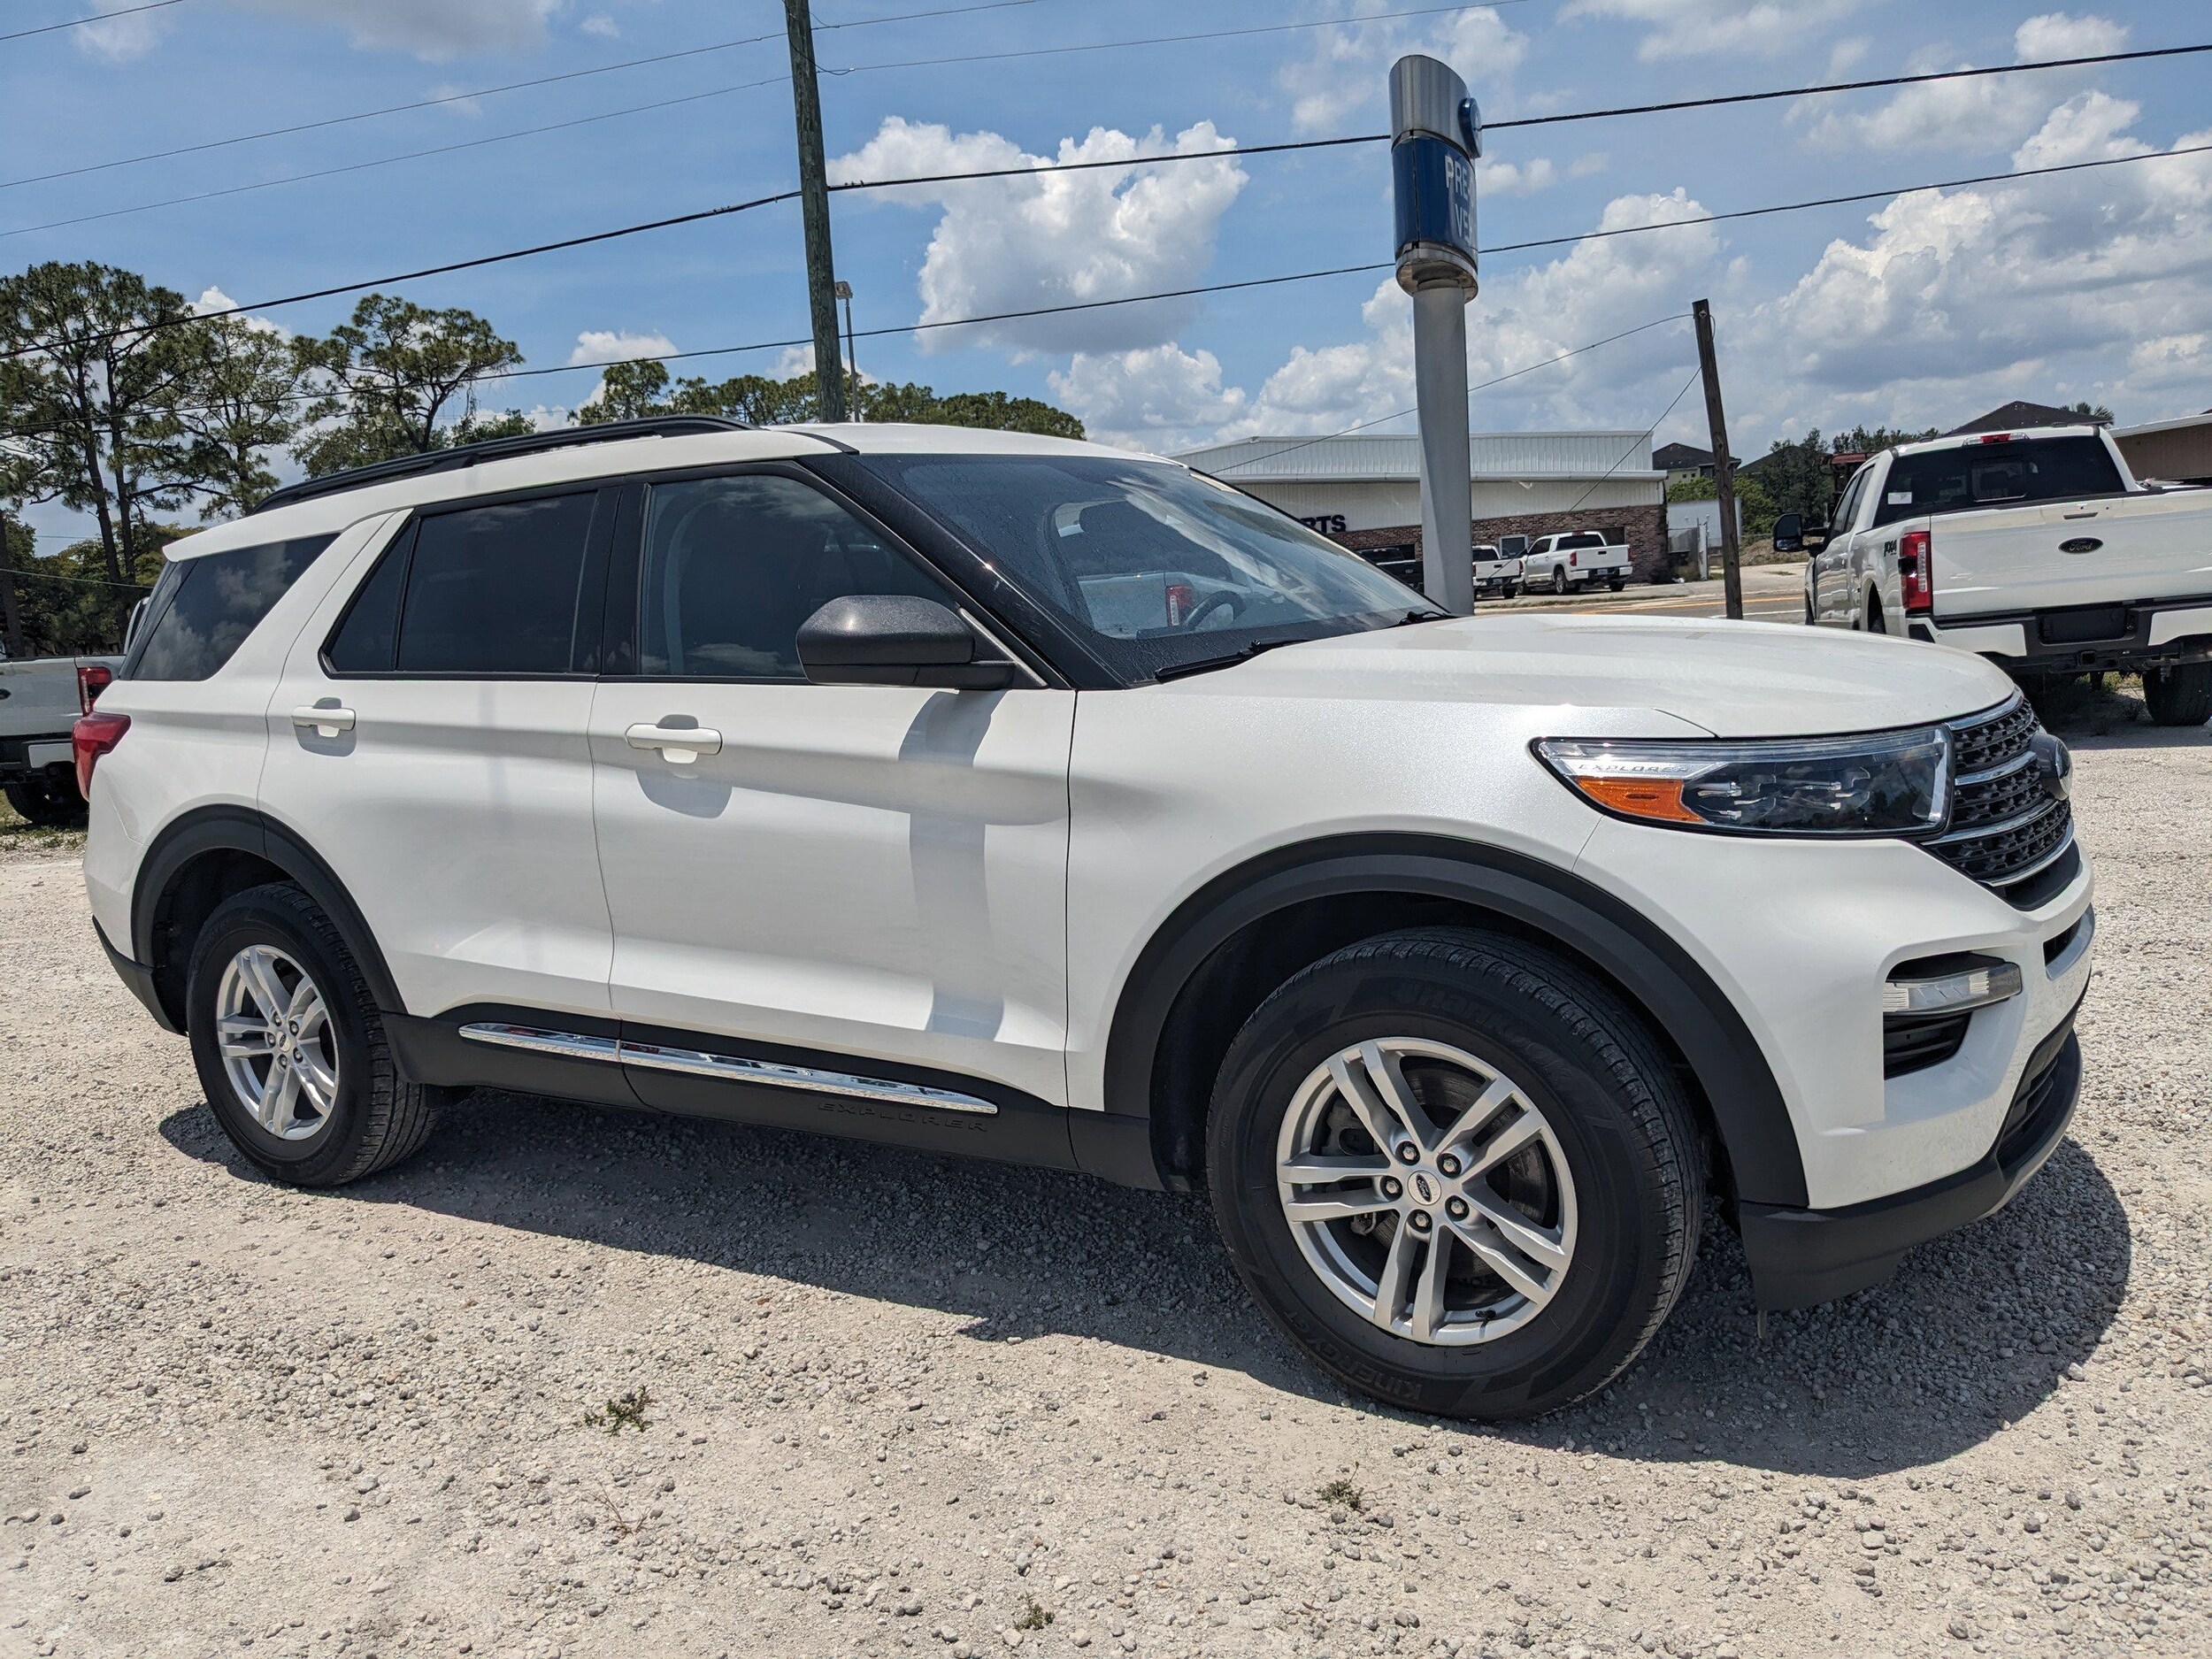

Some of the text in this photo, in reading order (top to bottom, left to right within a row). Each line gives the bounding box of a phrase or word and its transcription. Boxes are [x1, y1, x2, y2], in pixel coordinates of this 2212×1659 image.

[1445, 155, 1469, 202] PRE
[1578, 764, 1689, 772] EXPLORER
[818, 1102, 987, 1133] EXPLORER
